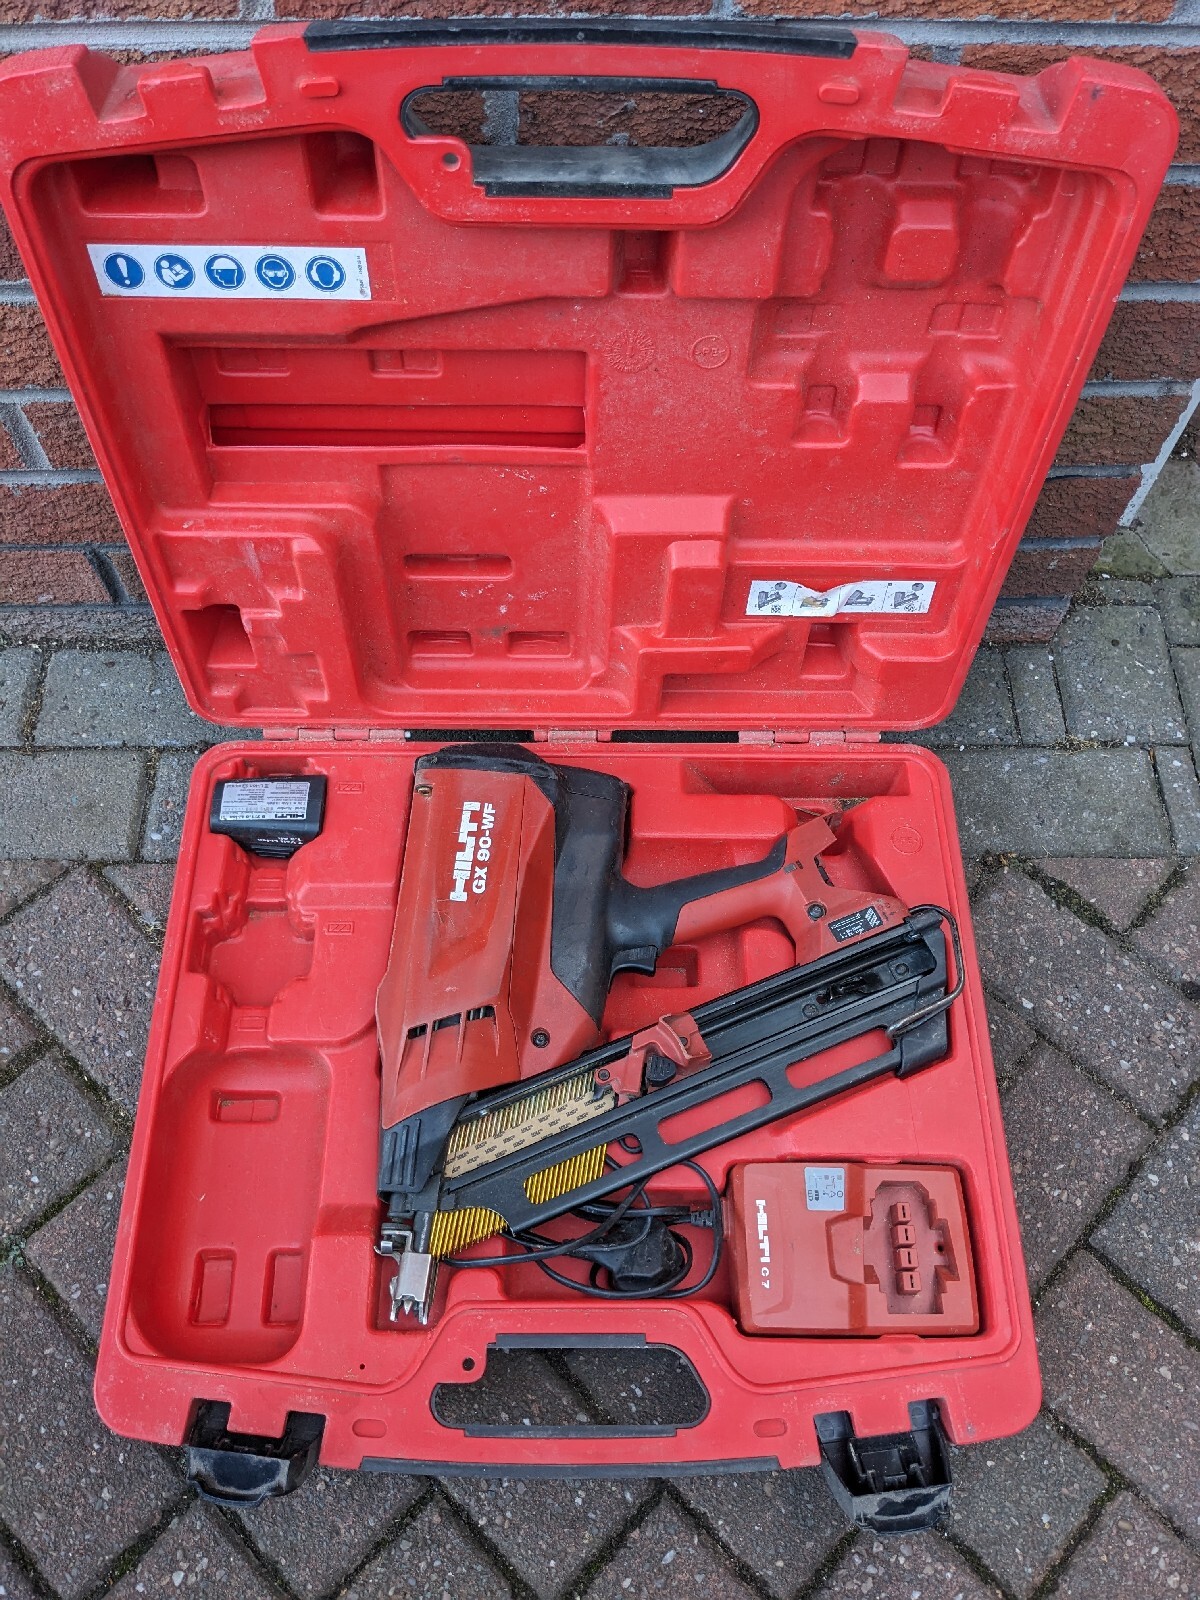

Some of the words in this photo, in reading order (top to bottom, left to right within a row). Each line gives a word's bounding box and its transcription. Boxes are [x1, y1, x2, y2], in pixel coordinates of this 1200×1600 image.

[450, 801, 481, 902] HILTI
[476, 802, 496, 862] 90-WF
[472, 865, 488, 894] GX
[755, 1199, 771, 1263] HILTI
[761, 1266, 770, 1277] C
[761, 1279, 770, 1289] 7
